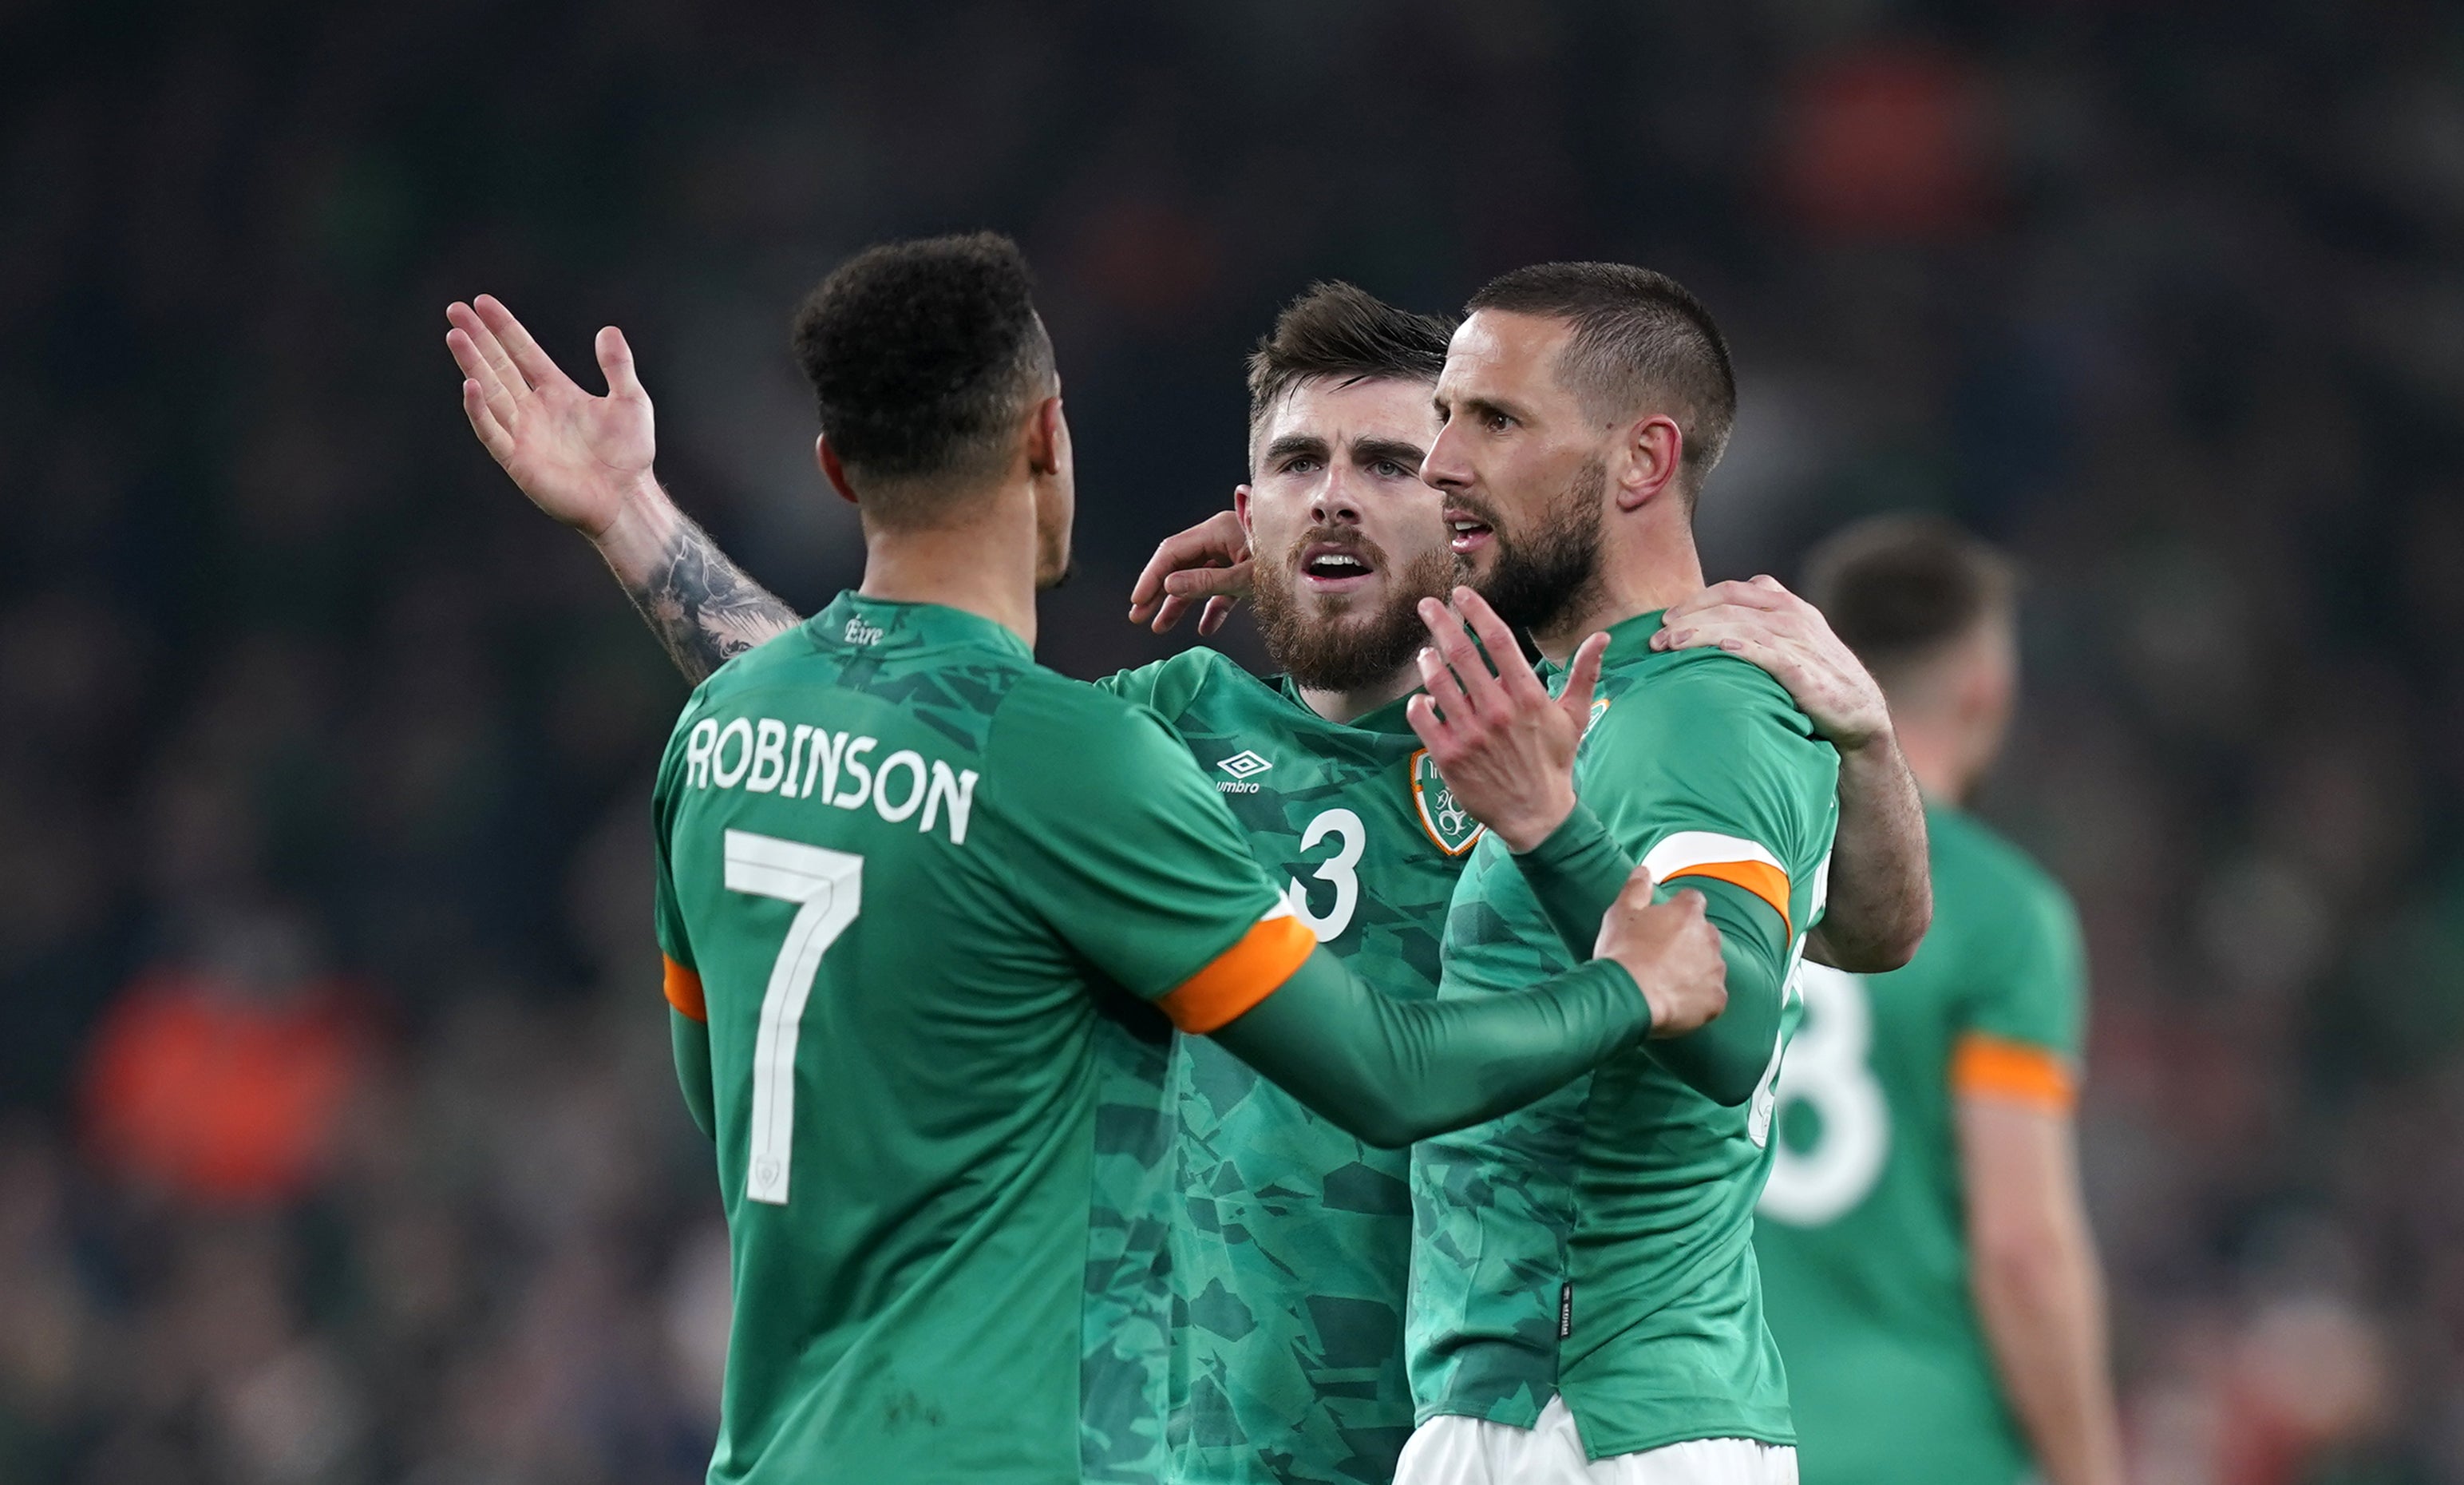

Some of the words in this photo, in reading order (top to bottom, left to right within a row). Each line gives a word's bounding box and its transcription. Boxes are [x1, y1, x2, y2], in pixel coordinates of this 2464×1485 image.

[844, 613, 883, 646] Éire
[686, 717, 979, 845] ROBINSON
[1216, 780, 1260, 794] umbro
[1289, 809, 1366, 943] 3
[724, 829, 864, 1204] 7
